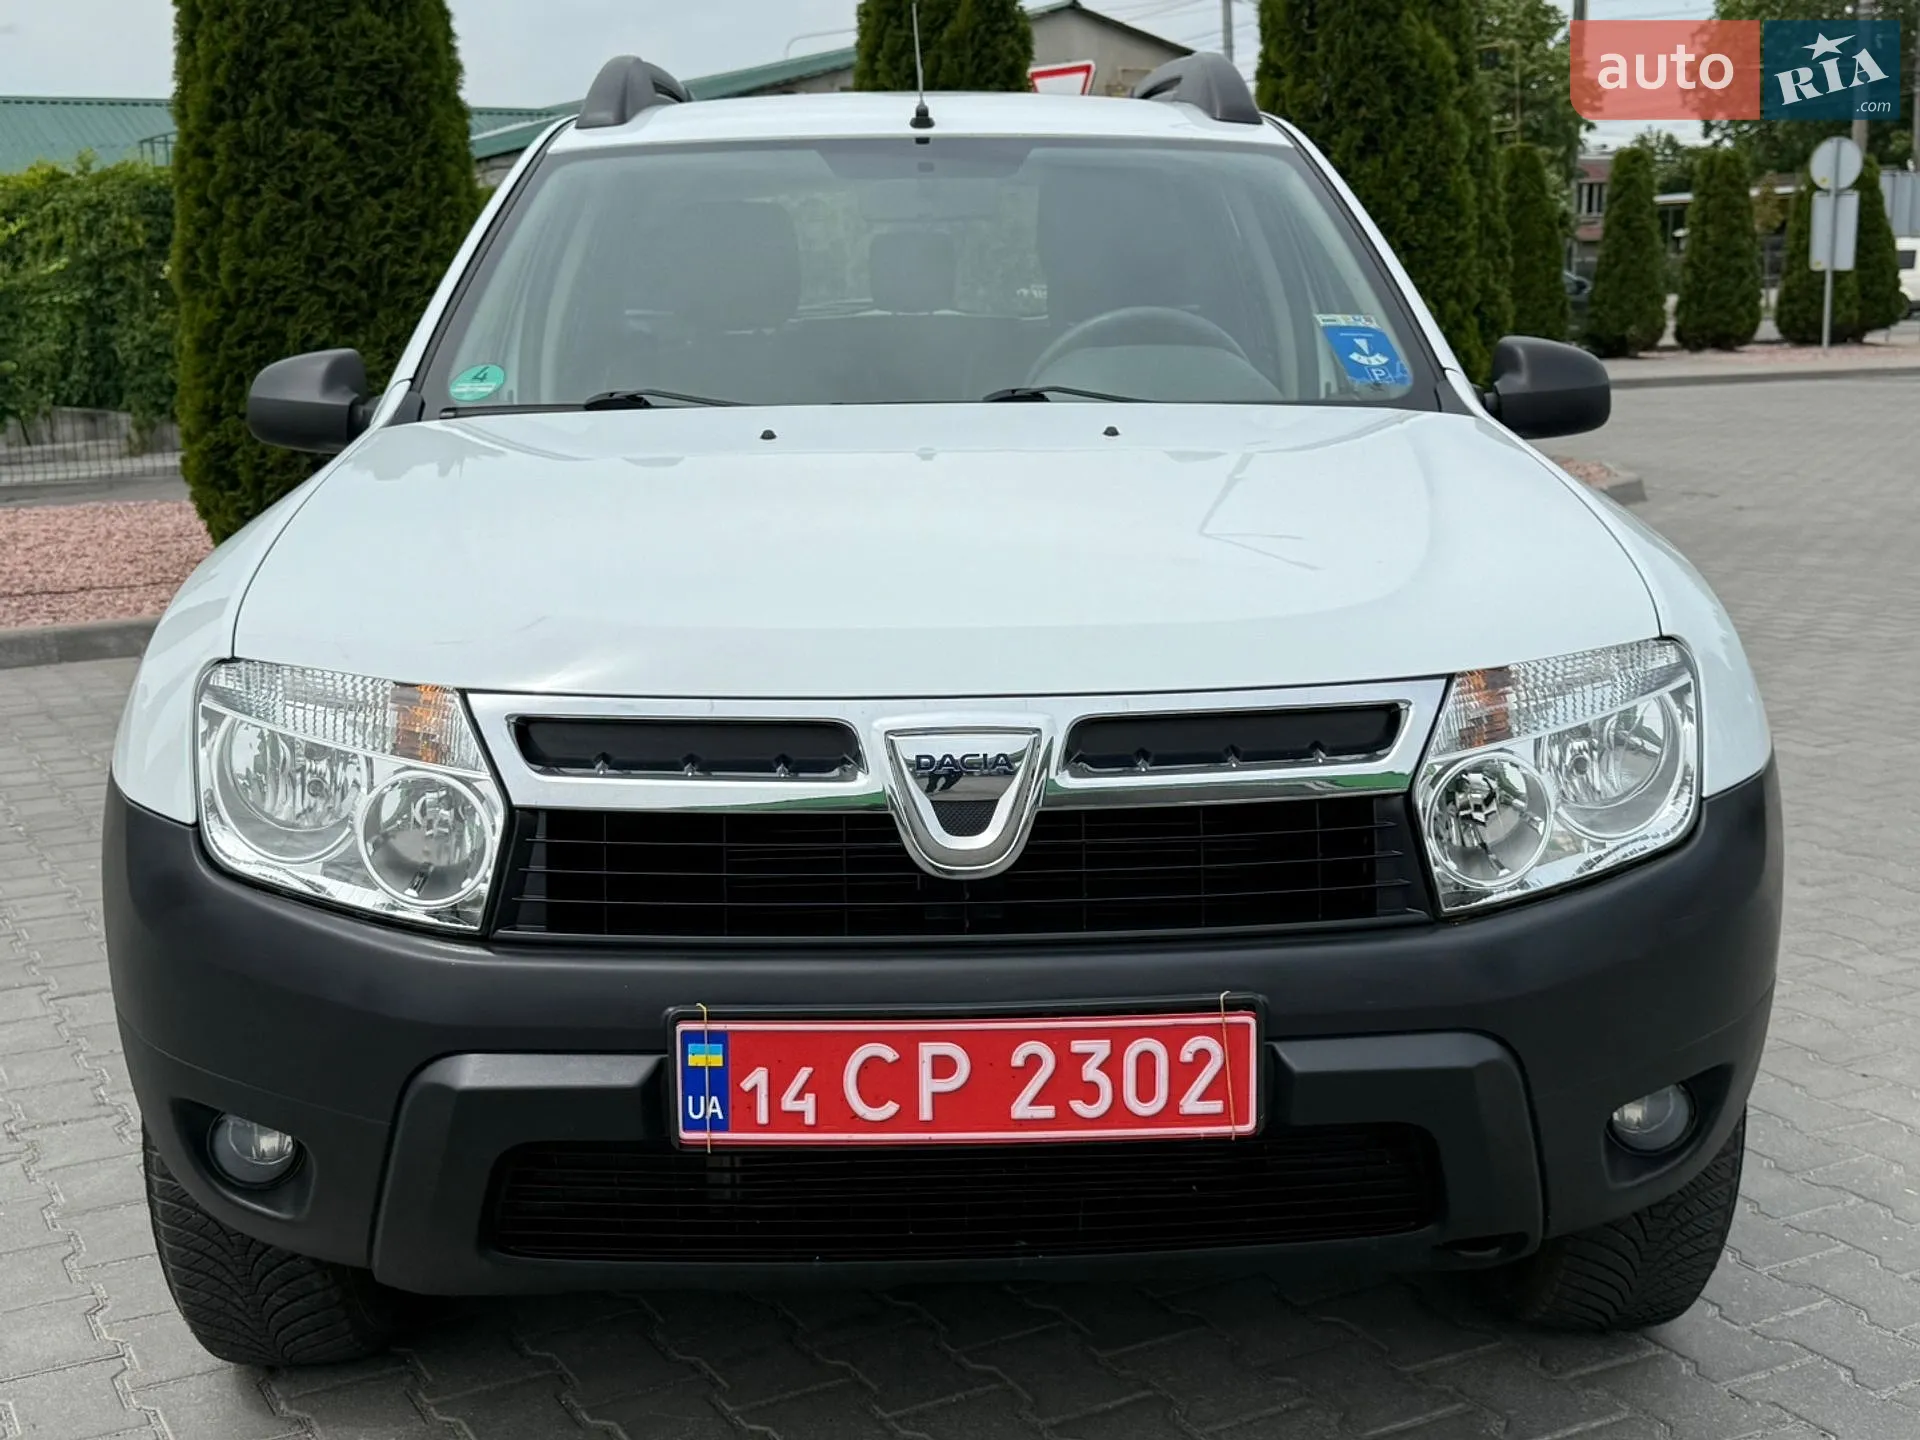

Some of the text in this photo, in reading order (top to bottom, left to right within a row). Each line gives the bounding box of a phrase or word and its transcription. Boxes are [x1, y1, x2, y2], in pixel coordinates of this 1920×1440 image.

[915, 753, 1014, 771] DACIA
[740, 1036, 1225, 1125] 14 CP 2302
[687, 1096, 724, 1119] UA
